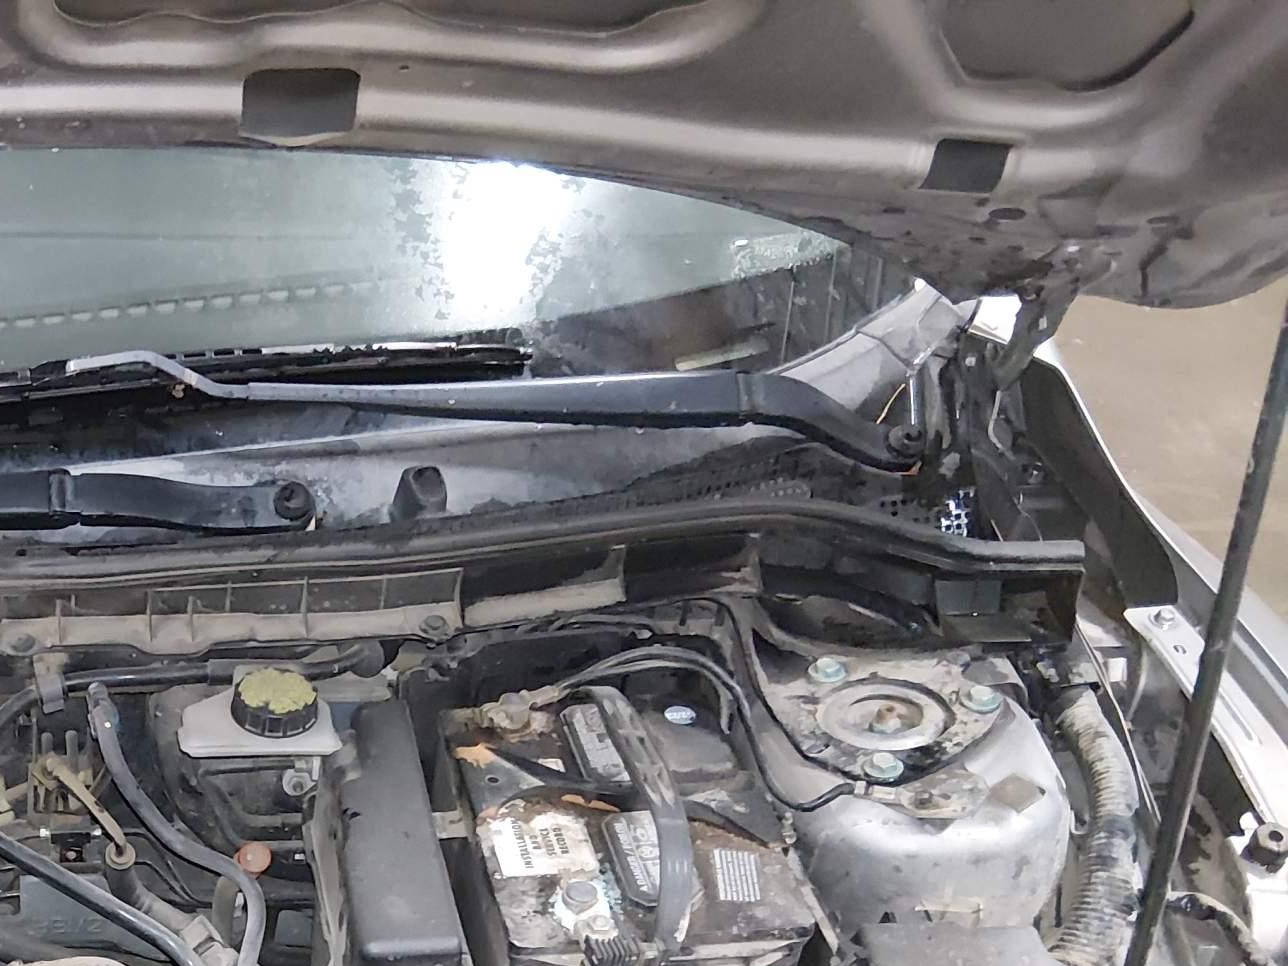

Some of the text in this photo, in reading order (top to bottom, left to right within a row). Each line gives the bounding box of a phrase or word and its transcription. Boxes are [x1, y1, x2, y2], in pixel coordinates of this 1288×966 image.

[529, 834, 542, 850] AND
[539, 828, 557, 857] SERVICE
[552, 827, 570, 855] RECORD
